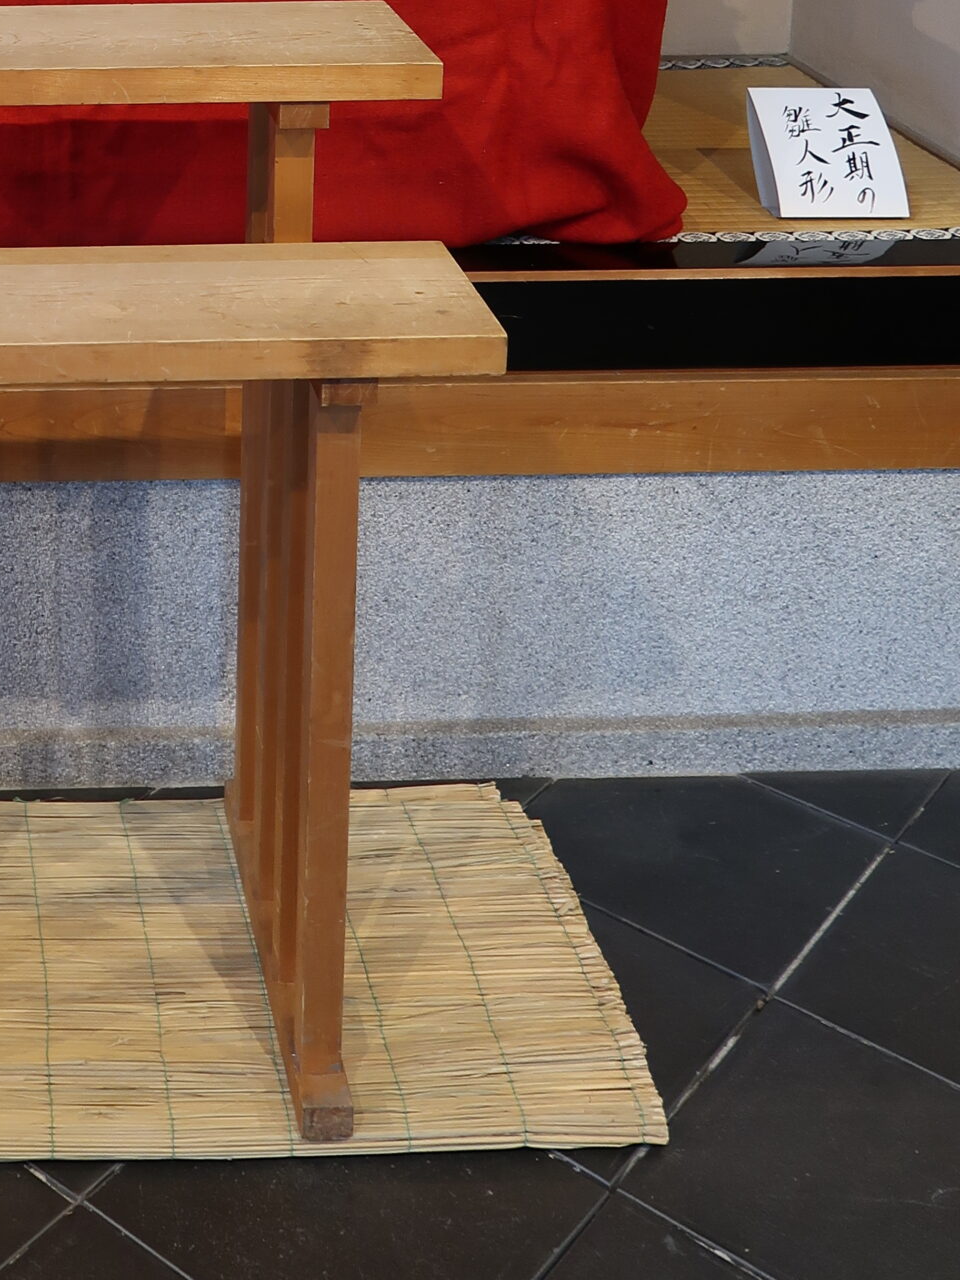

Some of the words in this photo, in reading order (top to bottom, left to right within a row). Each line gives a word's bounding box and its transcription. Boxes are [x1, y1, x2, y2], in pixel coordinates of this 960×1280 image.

[781, 105, 835, 204] 雛人形
[825, 91, 881, 214] 大正期の
